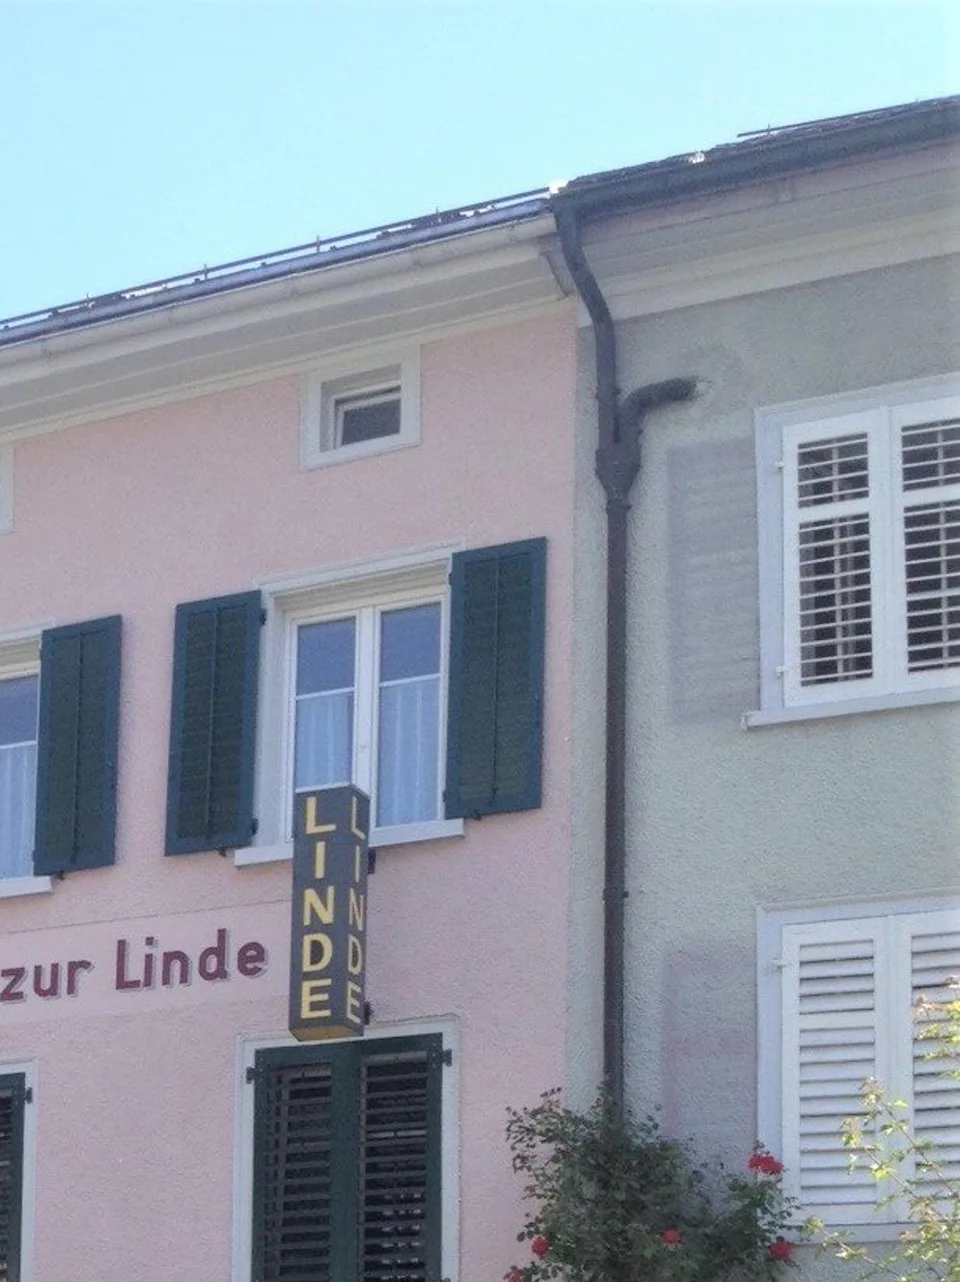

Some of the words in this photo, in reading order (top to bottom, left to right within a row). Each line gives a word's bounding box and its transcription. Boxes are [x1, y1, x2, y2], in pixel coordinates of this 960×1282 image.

[0, 957, 94, 1004] zur
[115, 926, 268, 991] Linde
[299, 795, 336, 1020] LINDE
[345, 795, 366, 1025] LINDE
